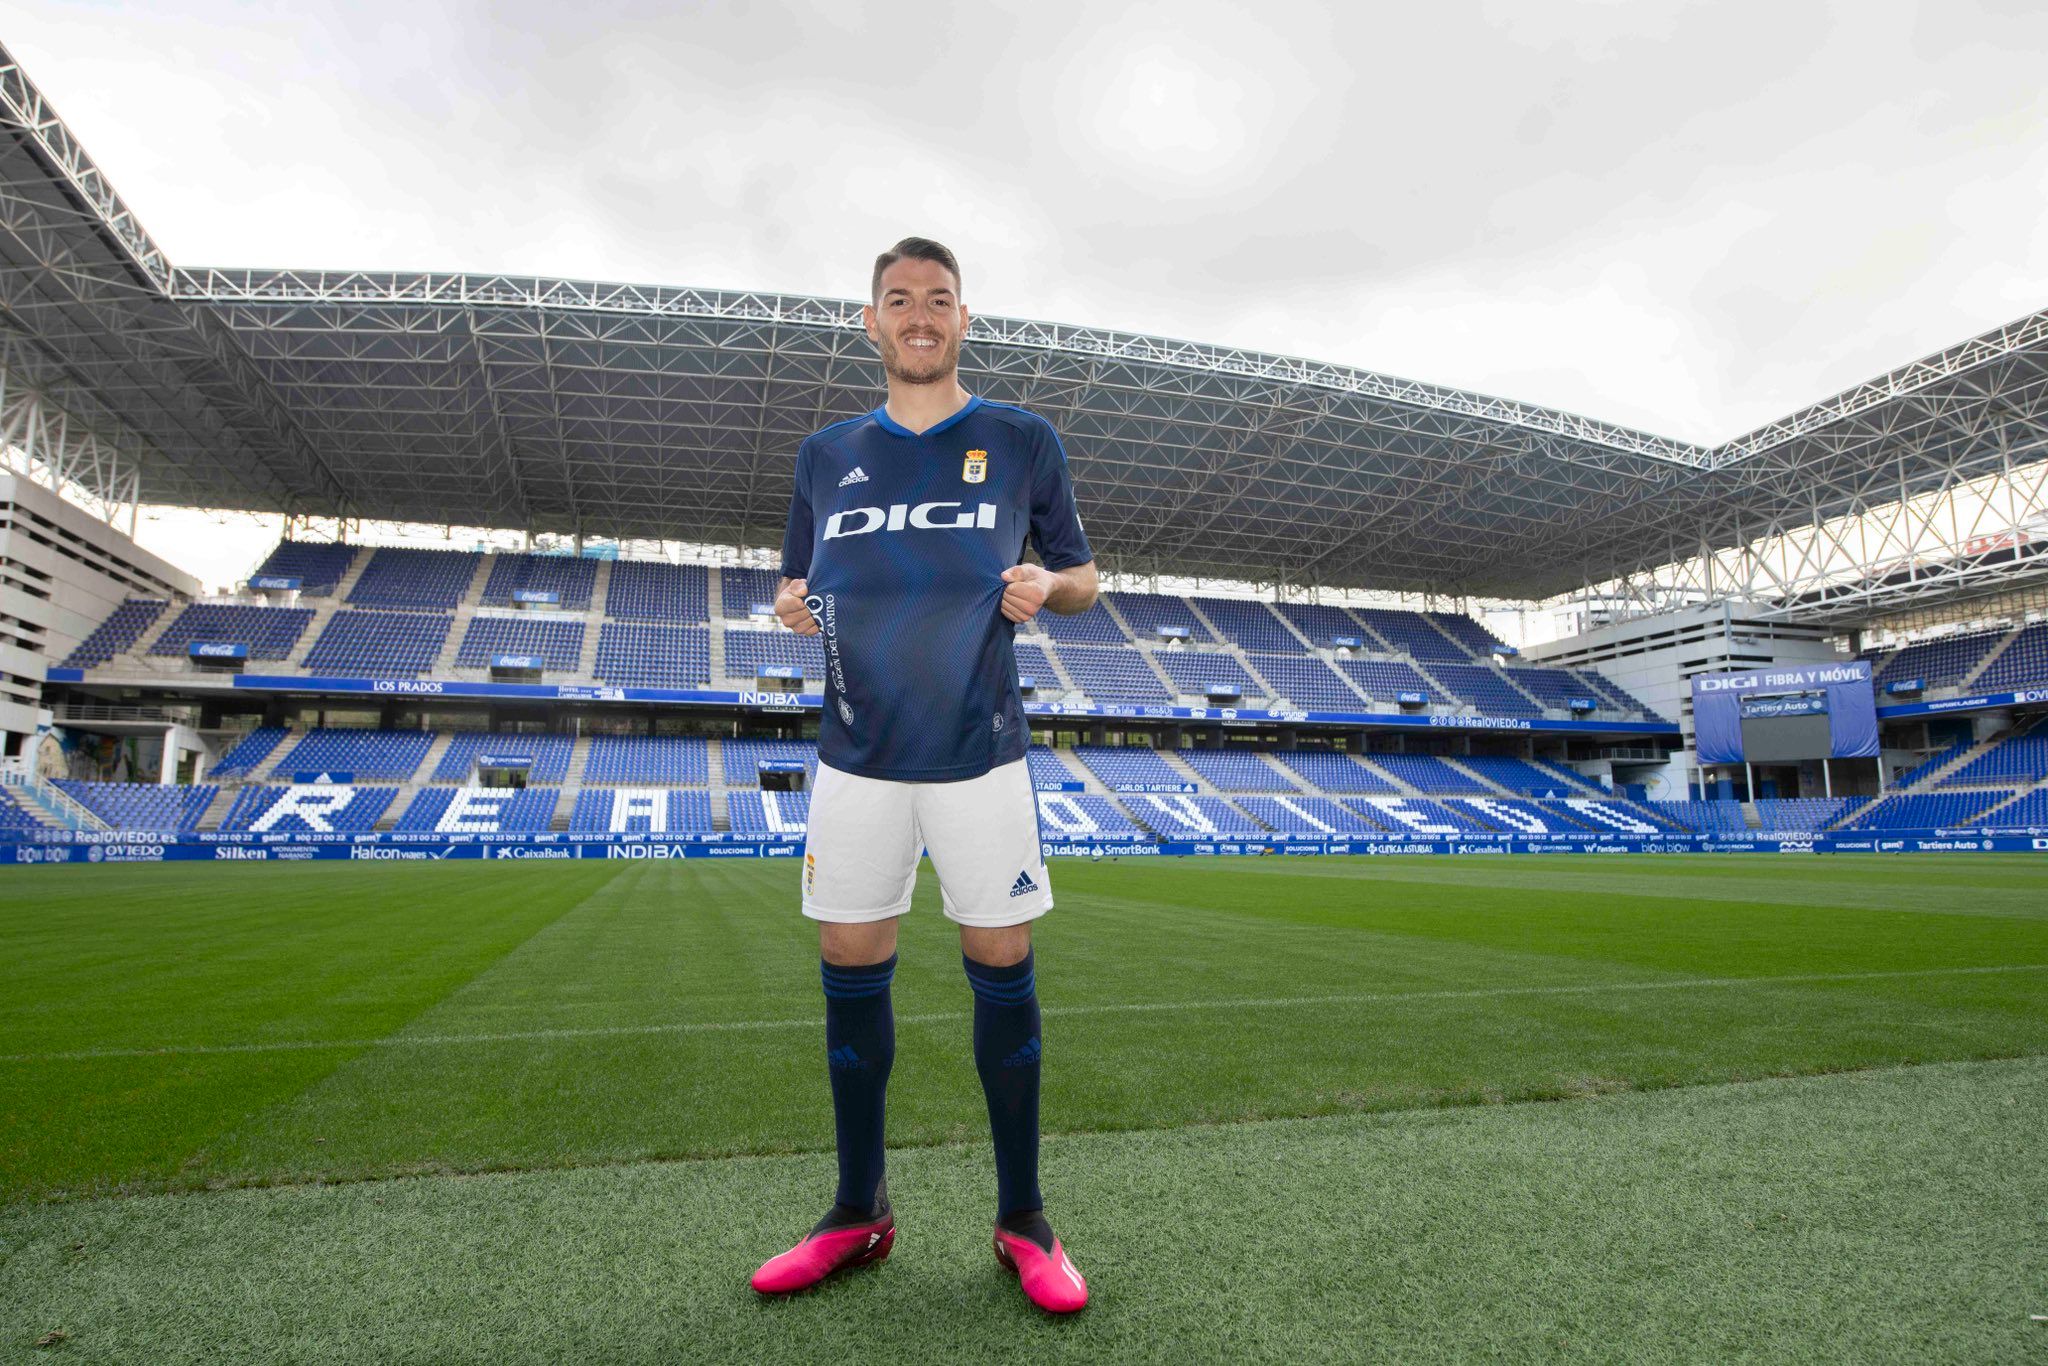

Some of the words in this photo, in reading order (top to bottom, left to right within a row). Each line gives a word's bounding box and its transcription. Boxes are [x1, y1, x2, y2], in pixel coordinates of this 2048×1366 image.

[839, 475, 870, 487] adidas
[823, 502, 997, 541] DIGI
[826, 594, 836, 636] CAMINO
[828, 638, 838, 656] DEL
[833, 656, 846, 693] ORIGEN
[1700, 676, 1758, 691] DIGI
[1765, 674, 1804, 686] FIBRA
[1807, 672, 1816, 683] Y
[1820, 668, 1864, 682] MÓVIL
[374, 680, 396, 691] LOS
[398, 682, 443, 692] PRADOS
[739, 692, 800, 704] INDIBA
[1744, 704, 1782, 713] Tartiere
[1784, 702, 1808, 710] Auto
[1036, 782, 1062, 790] STADIO
[1116, 784, 1144, 792] CARLOS
[1146, 784, 1182, 792] TARTIERE
[75, 830, 178, 843] RealOVIEDO.es
[1054, 844, 1090, 856] LaLiga
[1105, 844, 1160, 856] SmartBank
[1404, 844, 1433, 853] ASTURIAS
[1469, 844, 1504, 854] CaixaBank
[1917, 841, 1952, 849] Tartiere
[1954, 840, 1978, 849] Auto
[105, 846, 164, 856] OVIEDO
[216, 846, 267, 860] Silken
[351, 846, 400, 859] Halcon
[514, 846, 570, 859] CaixaBank
[608, 845, 686, 858] INDIBA
[1010, 884, 1038, 898] adidas
